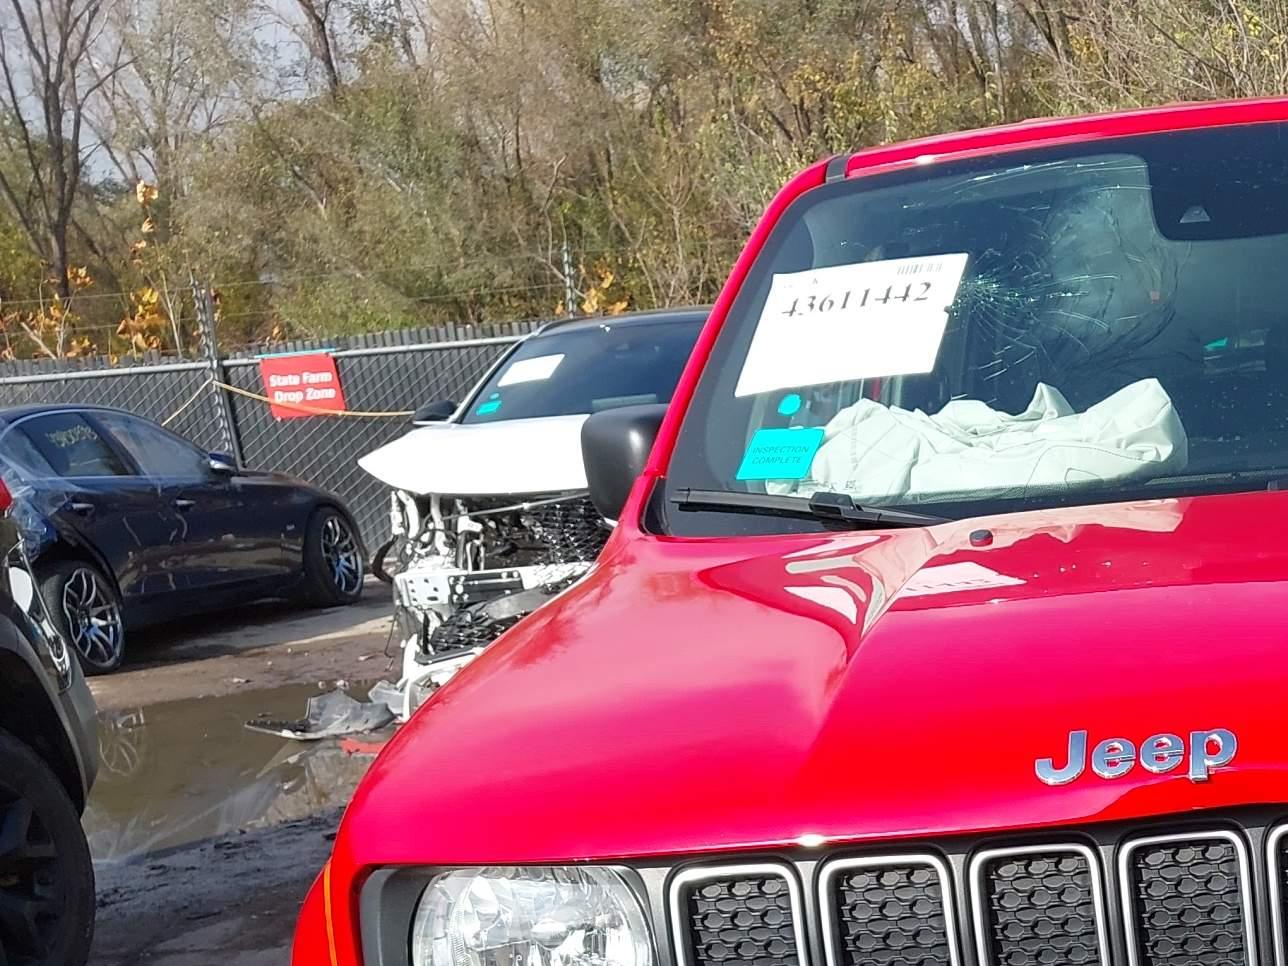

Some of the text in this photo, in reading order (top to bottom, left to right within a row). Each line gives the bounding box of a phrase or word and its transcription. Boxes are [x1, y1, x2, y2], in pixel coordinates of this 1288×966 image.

[780, 281, 932, 317] 43611442
[269, 371, 332, 387] State Farm
[274, 387, 336, 404] Drop Zone
[752, 445, 809, 454] INSPECTION
[751, 455, 803, 465] COMPLETE
[1034, 728, 1238, 786] Jeep
